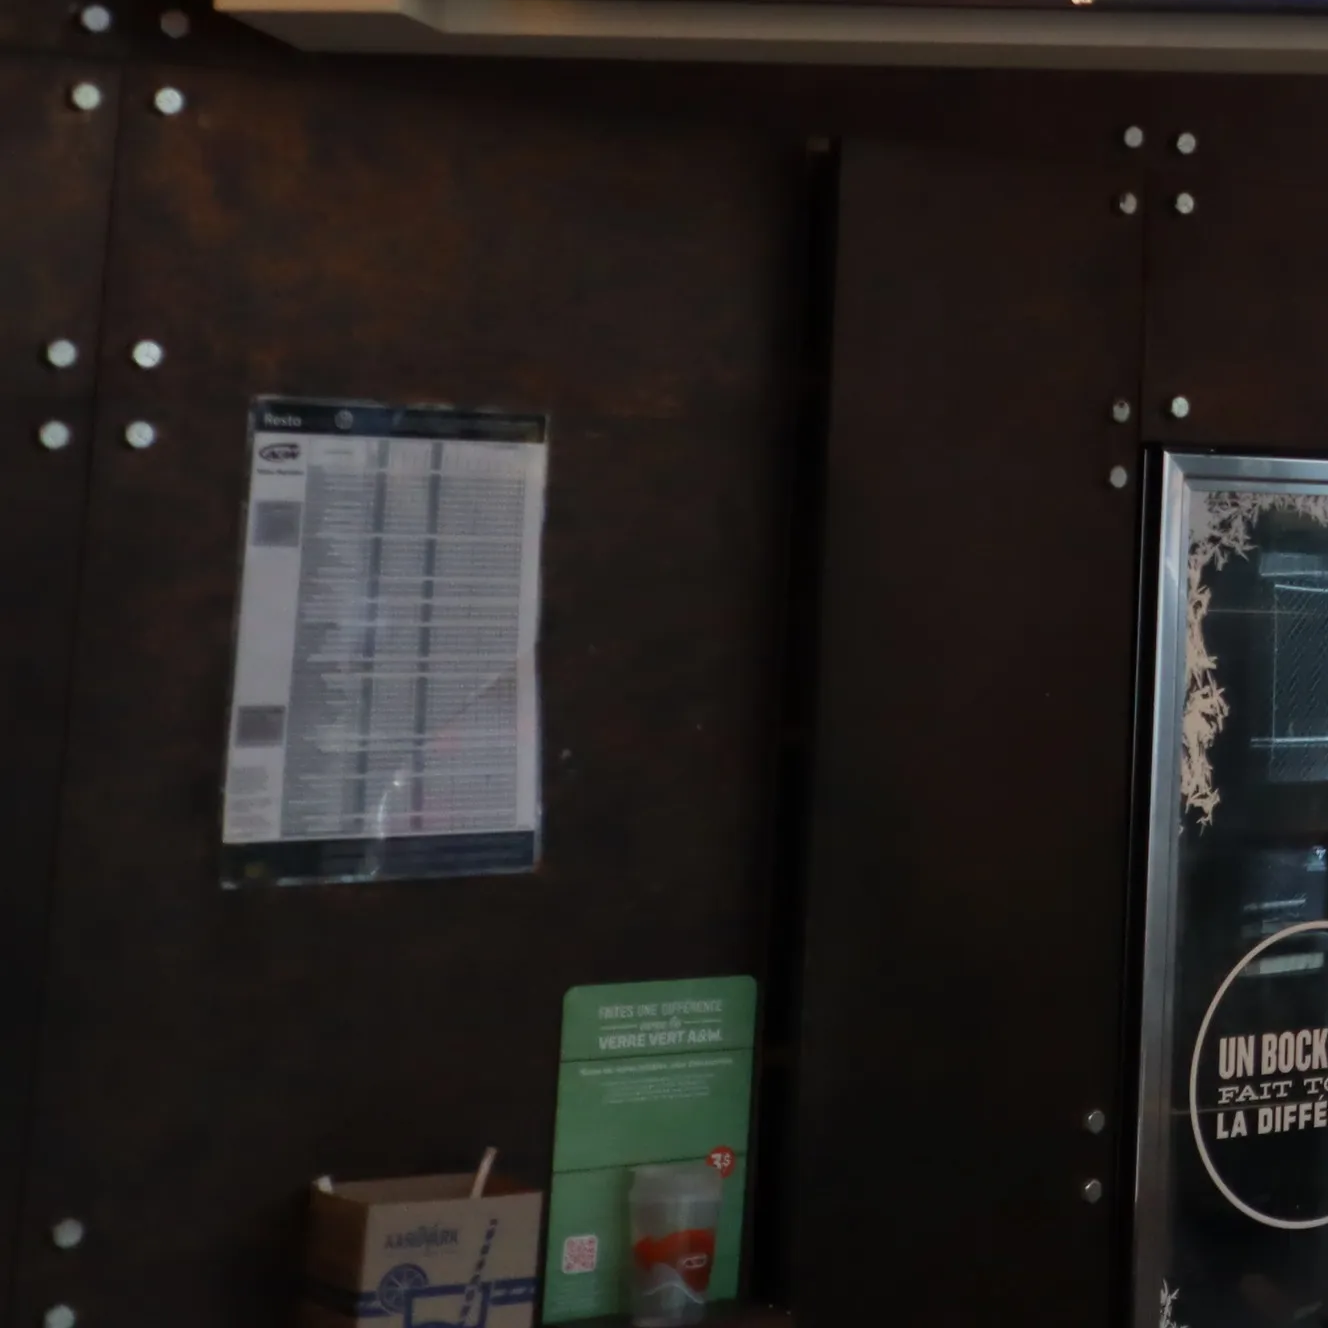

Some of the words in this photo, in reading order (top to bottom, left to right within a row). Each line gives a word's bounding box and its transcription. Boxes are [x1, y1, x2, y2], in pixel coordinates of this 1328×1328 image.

[1218, 1035, 1255, 1079] UN
[1261, 1028, 1328, 1075] BOCK
[1218, 1080, 1292, 1104] FAIT
[1216, 1111, 1247, 1139] LA
